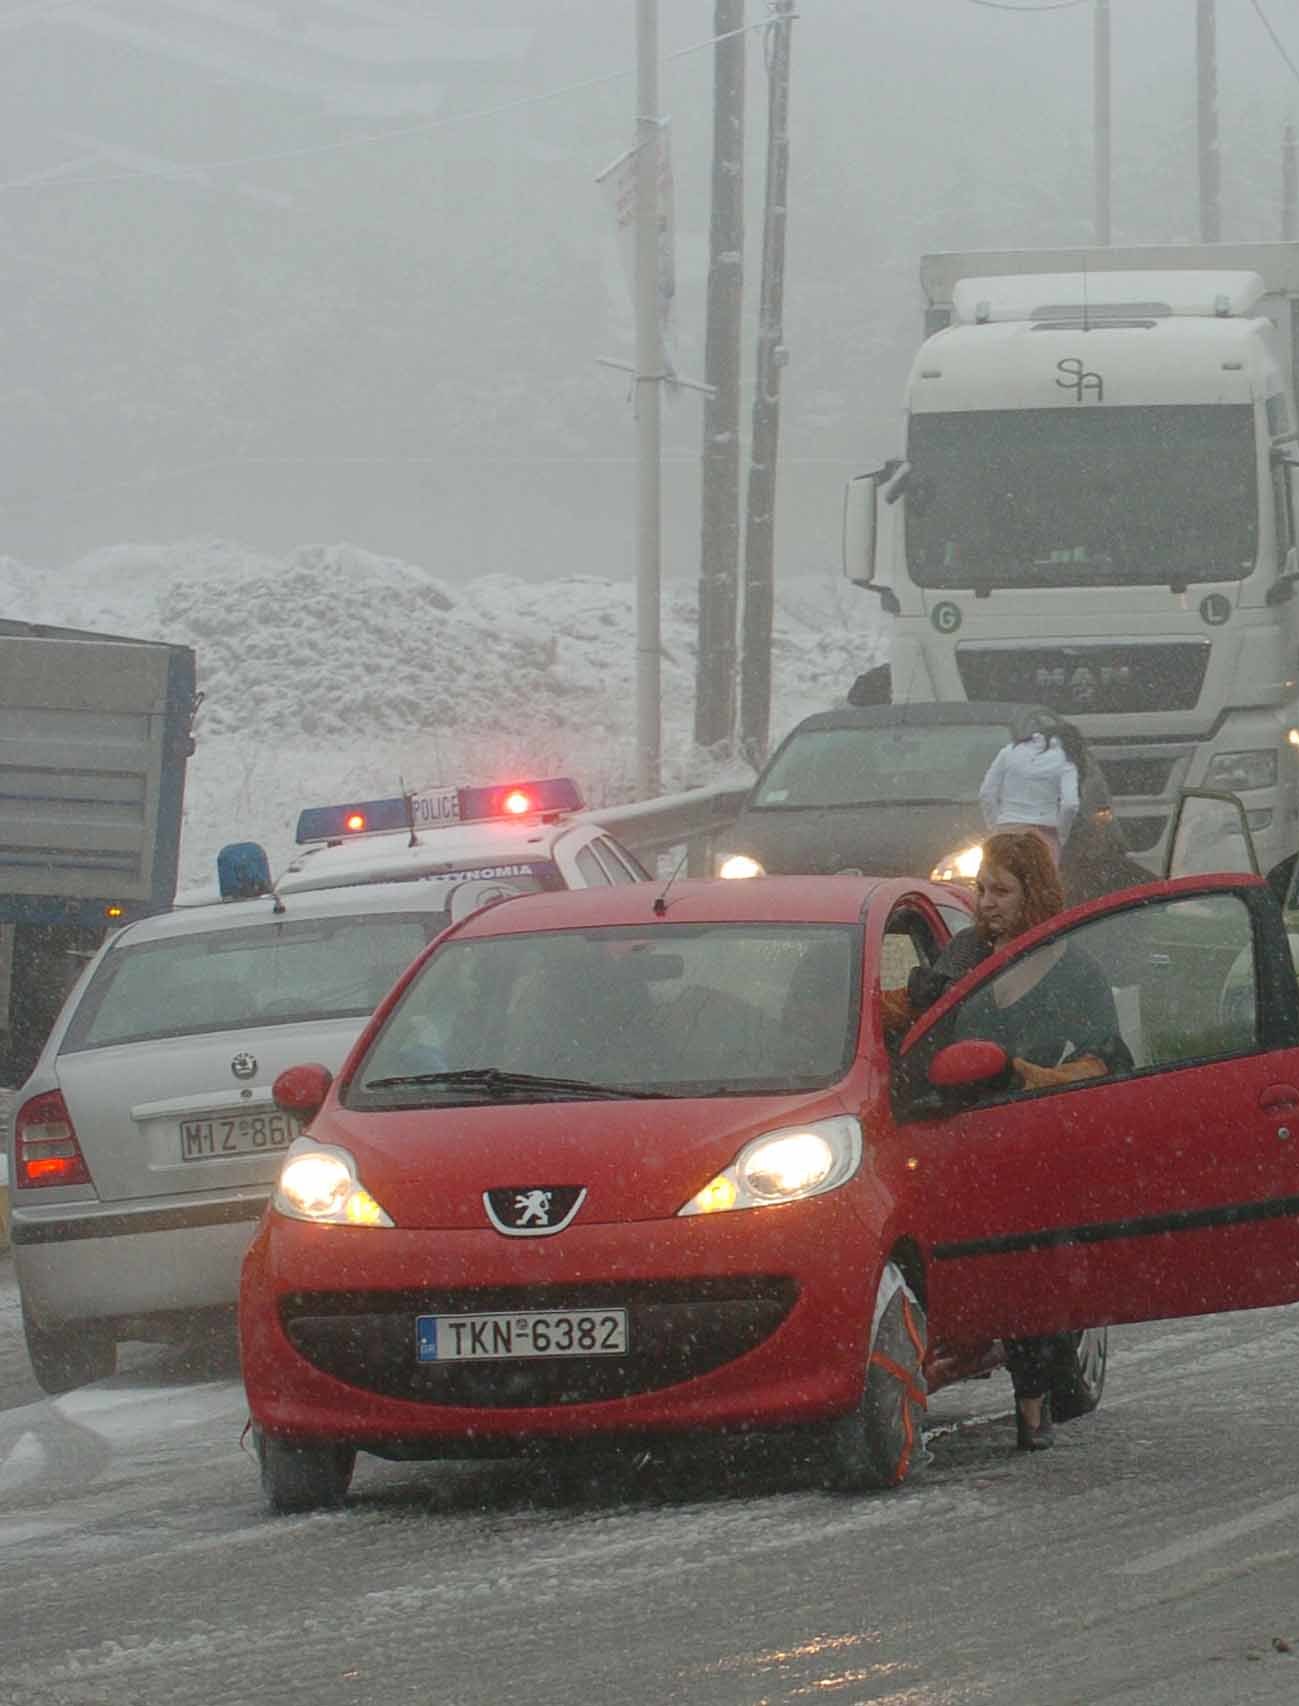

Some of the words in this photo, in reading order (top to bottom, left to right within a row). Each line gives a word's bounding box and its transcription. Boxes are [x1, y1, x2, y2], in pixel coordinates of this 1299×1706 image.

[1207, 600, 1224, 621] L
[413, 794, 459, 820] POLICE
[448, 1316, 620, 1355] TKN-6382
